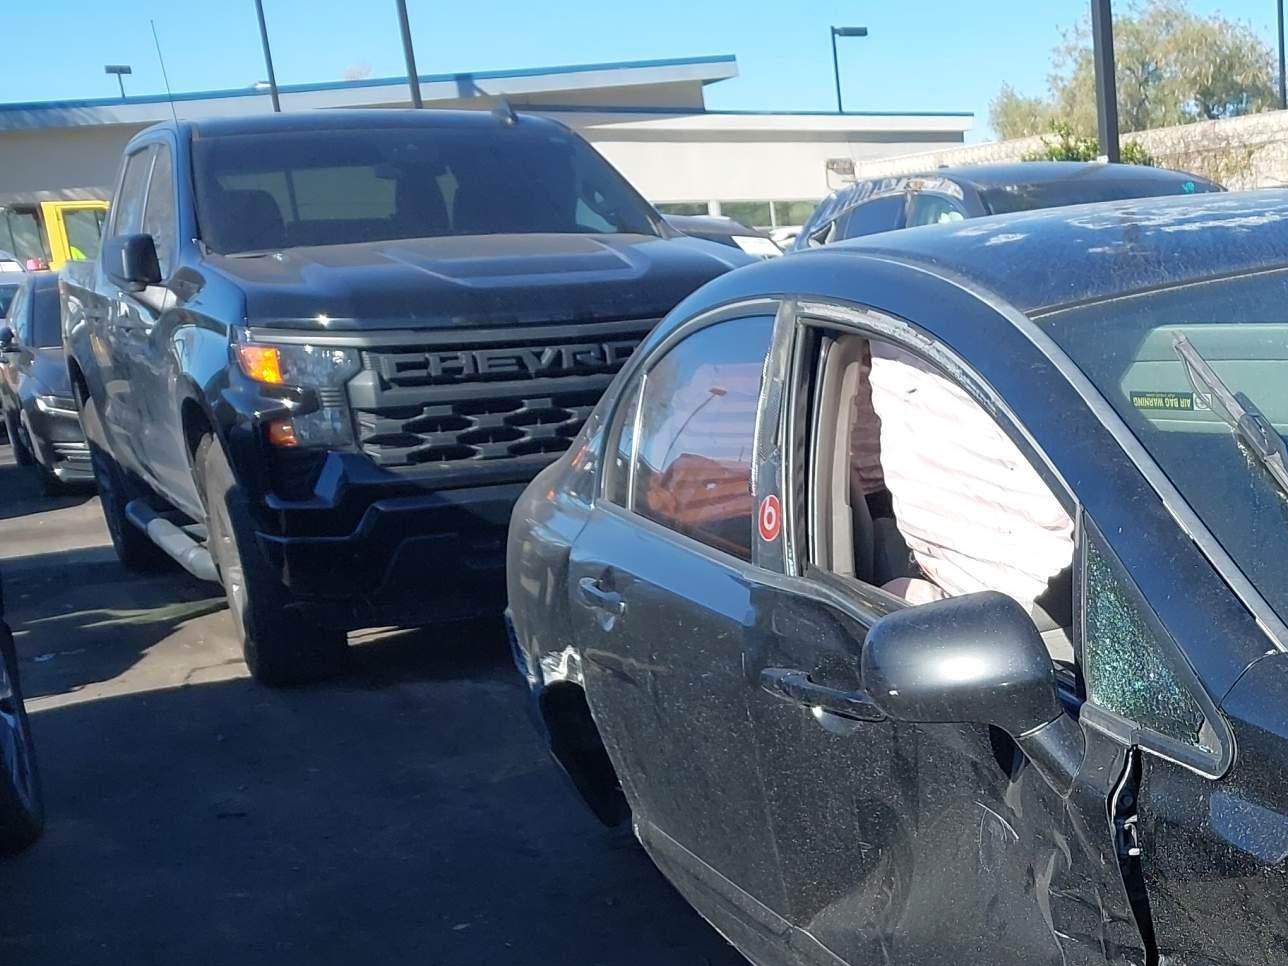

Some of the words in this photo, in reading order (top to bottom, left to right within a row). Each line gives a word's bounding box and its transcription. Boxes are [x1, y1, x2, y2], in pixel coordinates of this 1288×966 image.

[1132, 396, 1164, 407] WARNING
[1164, 398, 1179, 408] BAG
[1180, 398, 1191, 408] AIR
